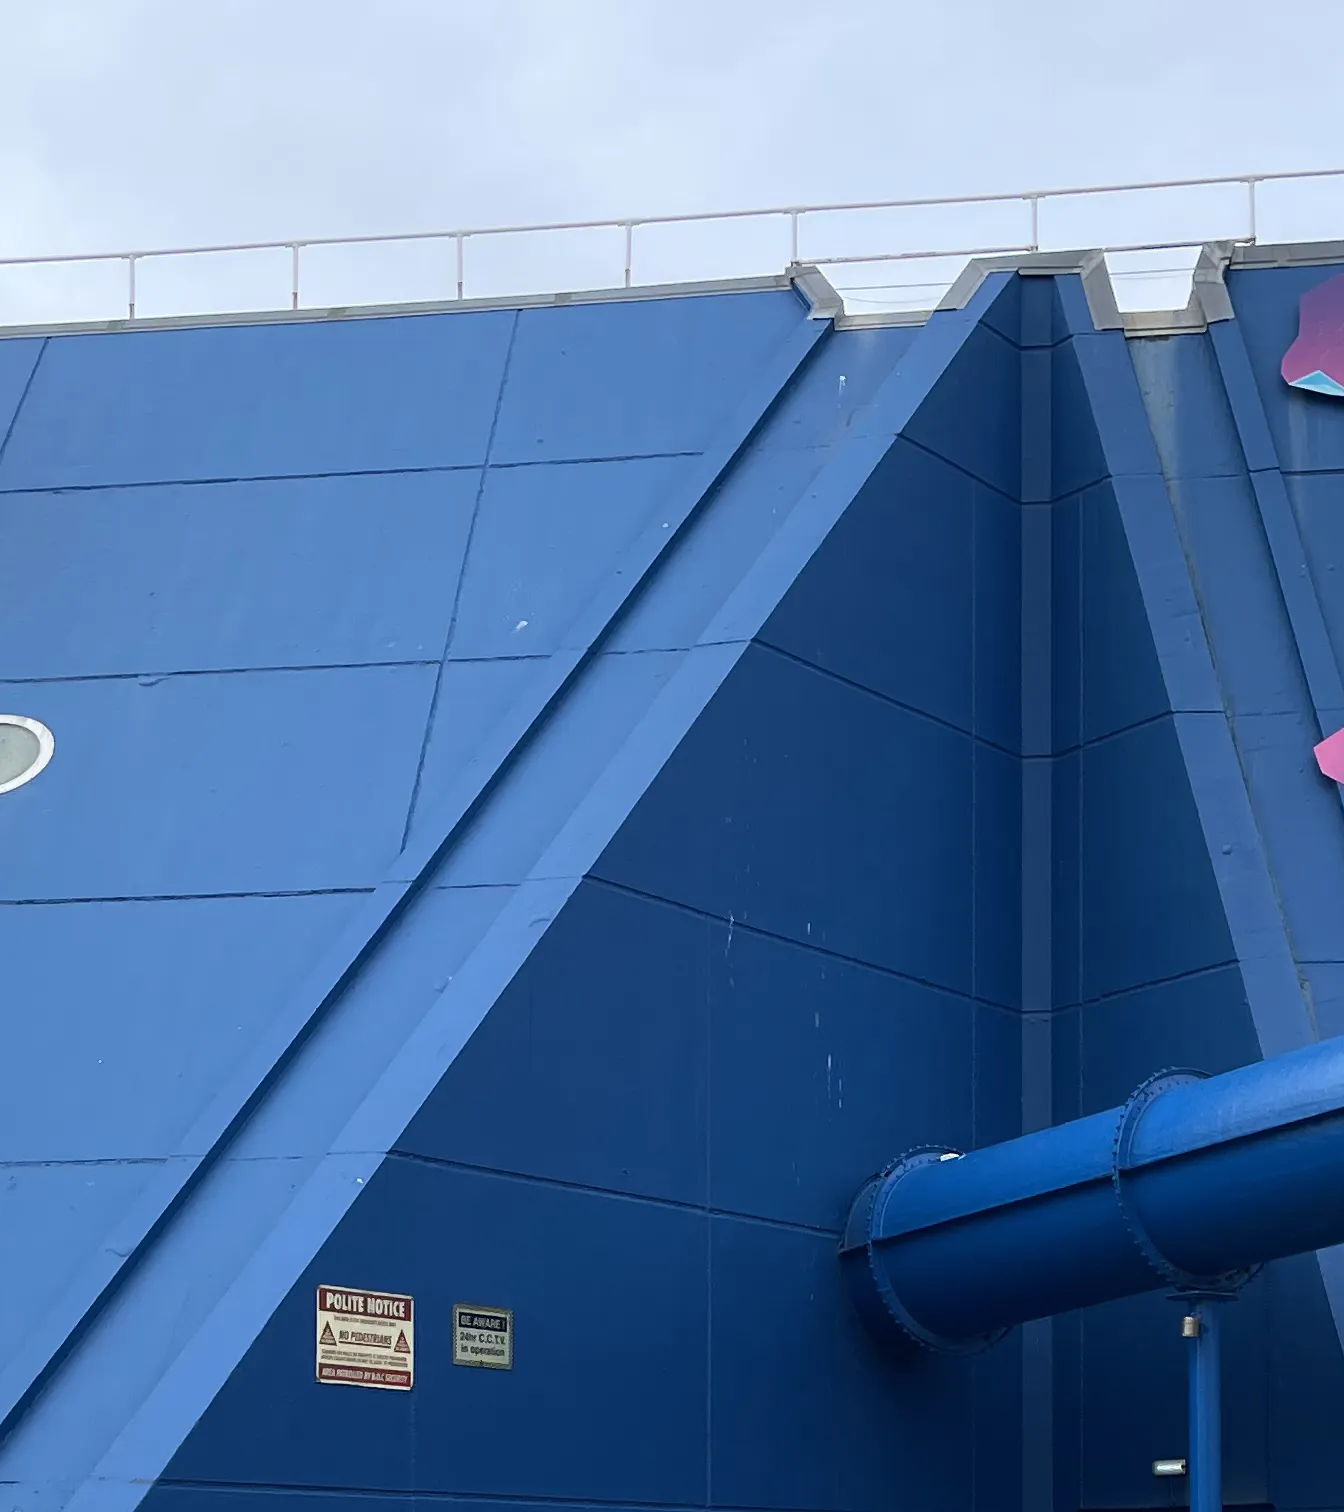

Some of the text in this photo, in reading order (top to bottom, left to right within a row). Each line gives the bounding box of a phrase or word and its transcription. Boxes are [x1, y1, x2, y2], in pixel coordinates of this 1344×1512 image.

[326, 1291, 406, 1318] POLITE NOTICE
[460, 1314, 472, 1326] BE
[472, 1316, 501, 1330] AWARE
[338, 1330, 349, 1340] NO
[350, 1331, 393, 1345] PEDESTRIANS
[460, 1343, 505, 1357] in operation
